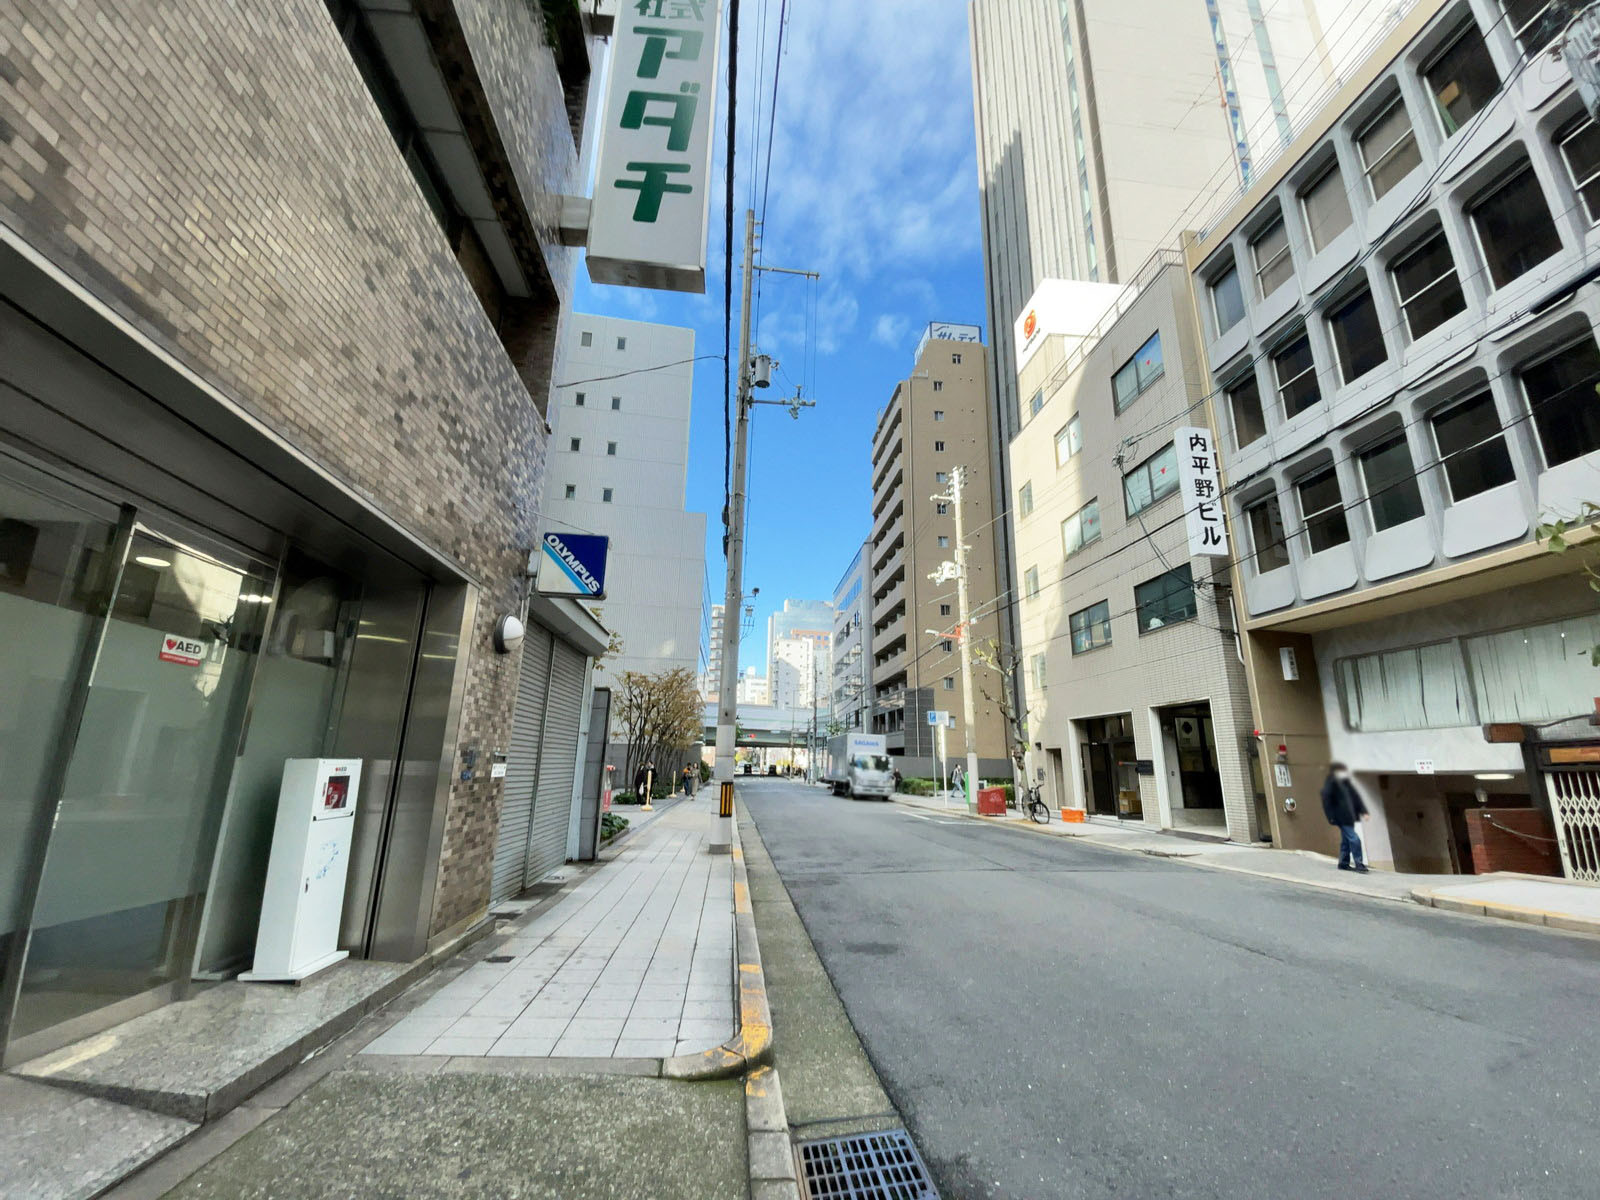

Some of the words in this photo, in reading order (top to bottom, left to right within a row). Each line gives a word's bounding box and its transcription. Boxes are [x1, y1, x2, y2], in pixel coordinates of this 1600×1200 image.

[613, 26, 703, 223] アダチ
[1189, 433, 1222, 546] 内平野ビル
[547, 534, 601, 593] OLYMPUS
[176, 641, 201, 654] AED
